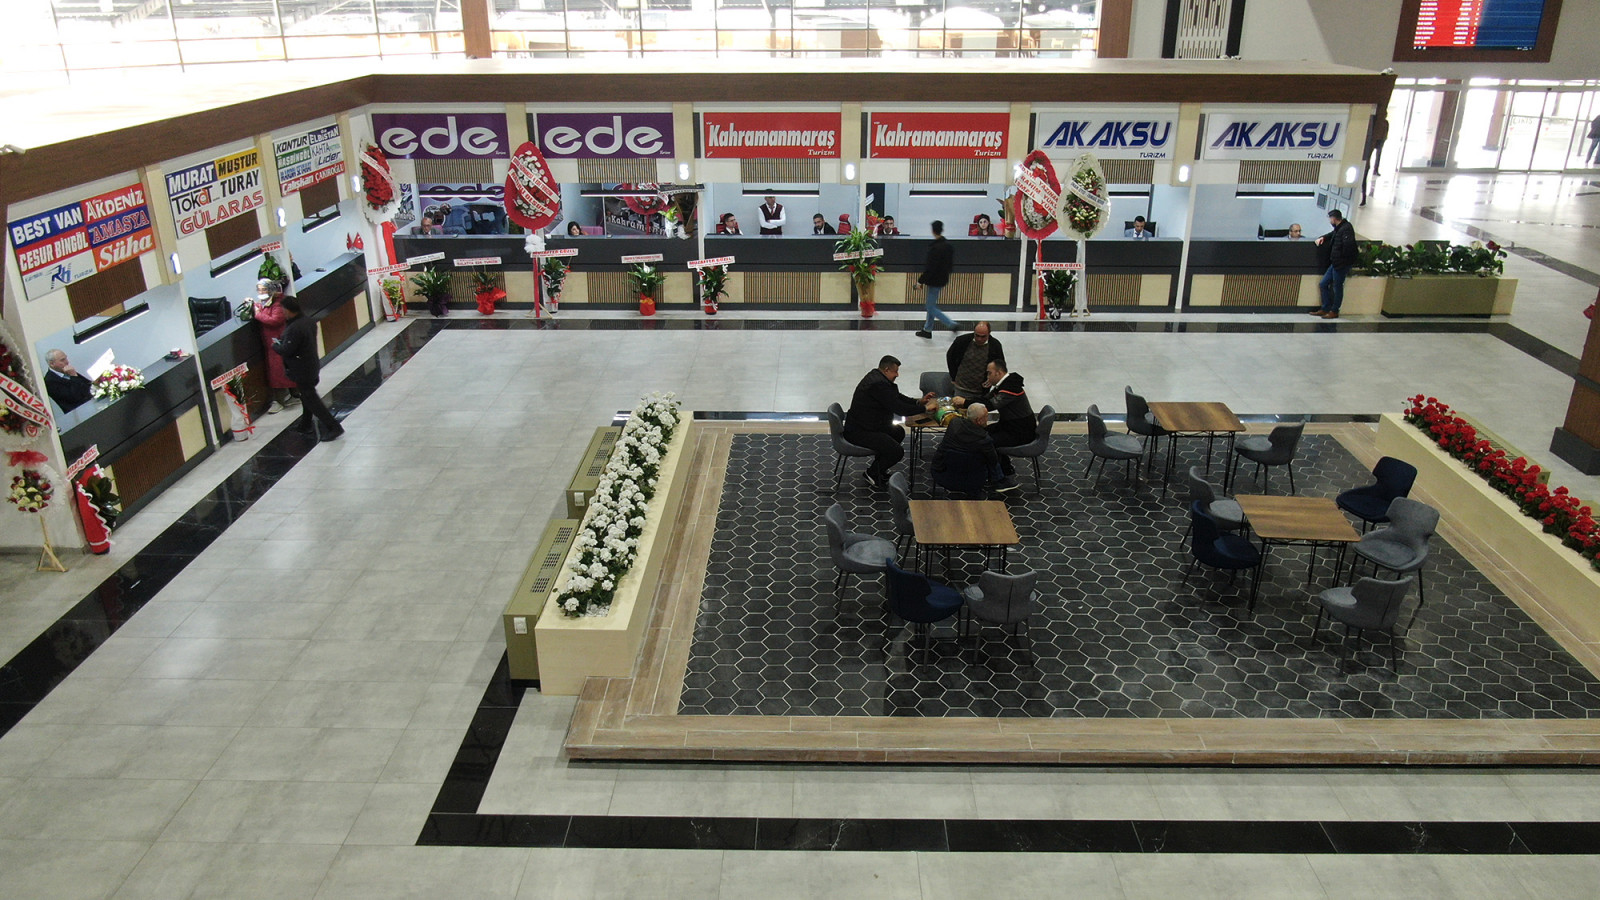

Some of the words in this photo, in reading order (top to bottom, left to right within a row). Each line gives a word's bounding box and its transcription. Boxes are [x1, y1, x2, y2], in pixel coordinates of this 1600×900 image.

[380, 116, 499, 156] ede
[544, 115, 664, 155] ede
[708, 123, 836, 149] Kahramanmaraş
[875, 123, 1003, 149] Kahramanmaraş
[1043, 121, 1090, 147] AK
[1086, 121, 1171, 147] AKSU
[1211, 122, 1258, 147] AK
[1254, 122, 1341, 148] AKSU
[168, 163, 215, 195] MURAT
[220, 169, 260, 198] TURAY
[85, 188, 145, 222] AKDENİZ
[180, 190, 265, 235] GÜLARAS
[1041, 200, 1057, 218] YÜKS
[12, 216, 51, 245] BEST
[54, 207, 83, 230] VAN
[92, 210, 150, 244] AMASYA
[19, 250, 55, 272] CESUR
[54, 231, 89, 260] BİNGÖL
[98, 234, 153, 269] Süha
[4, 398, 52, 430] OLSUN
